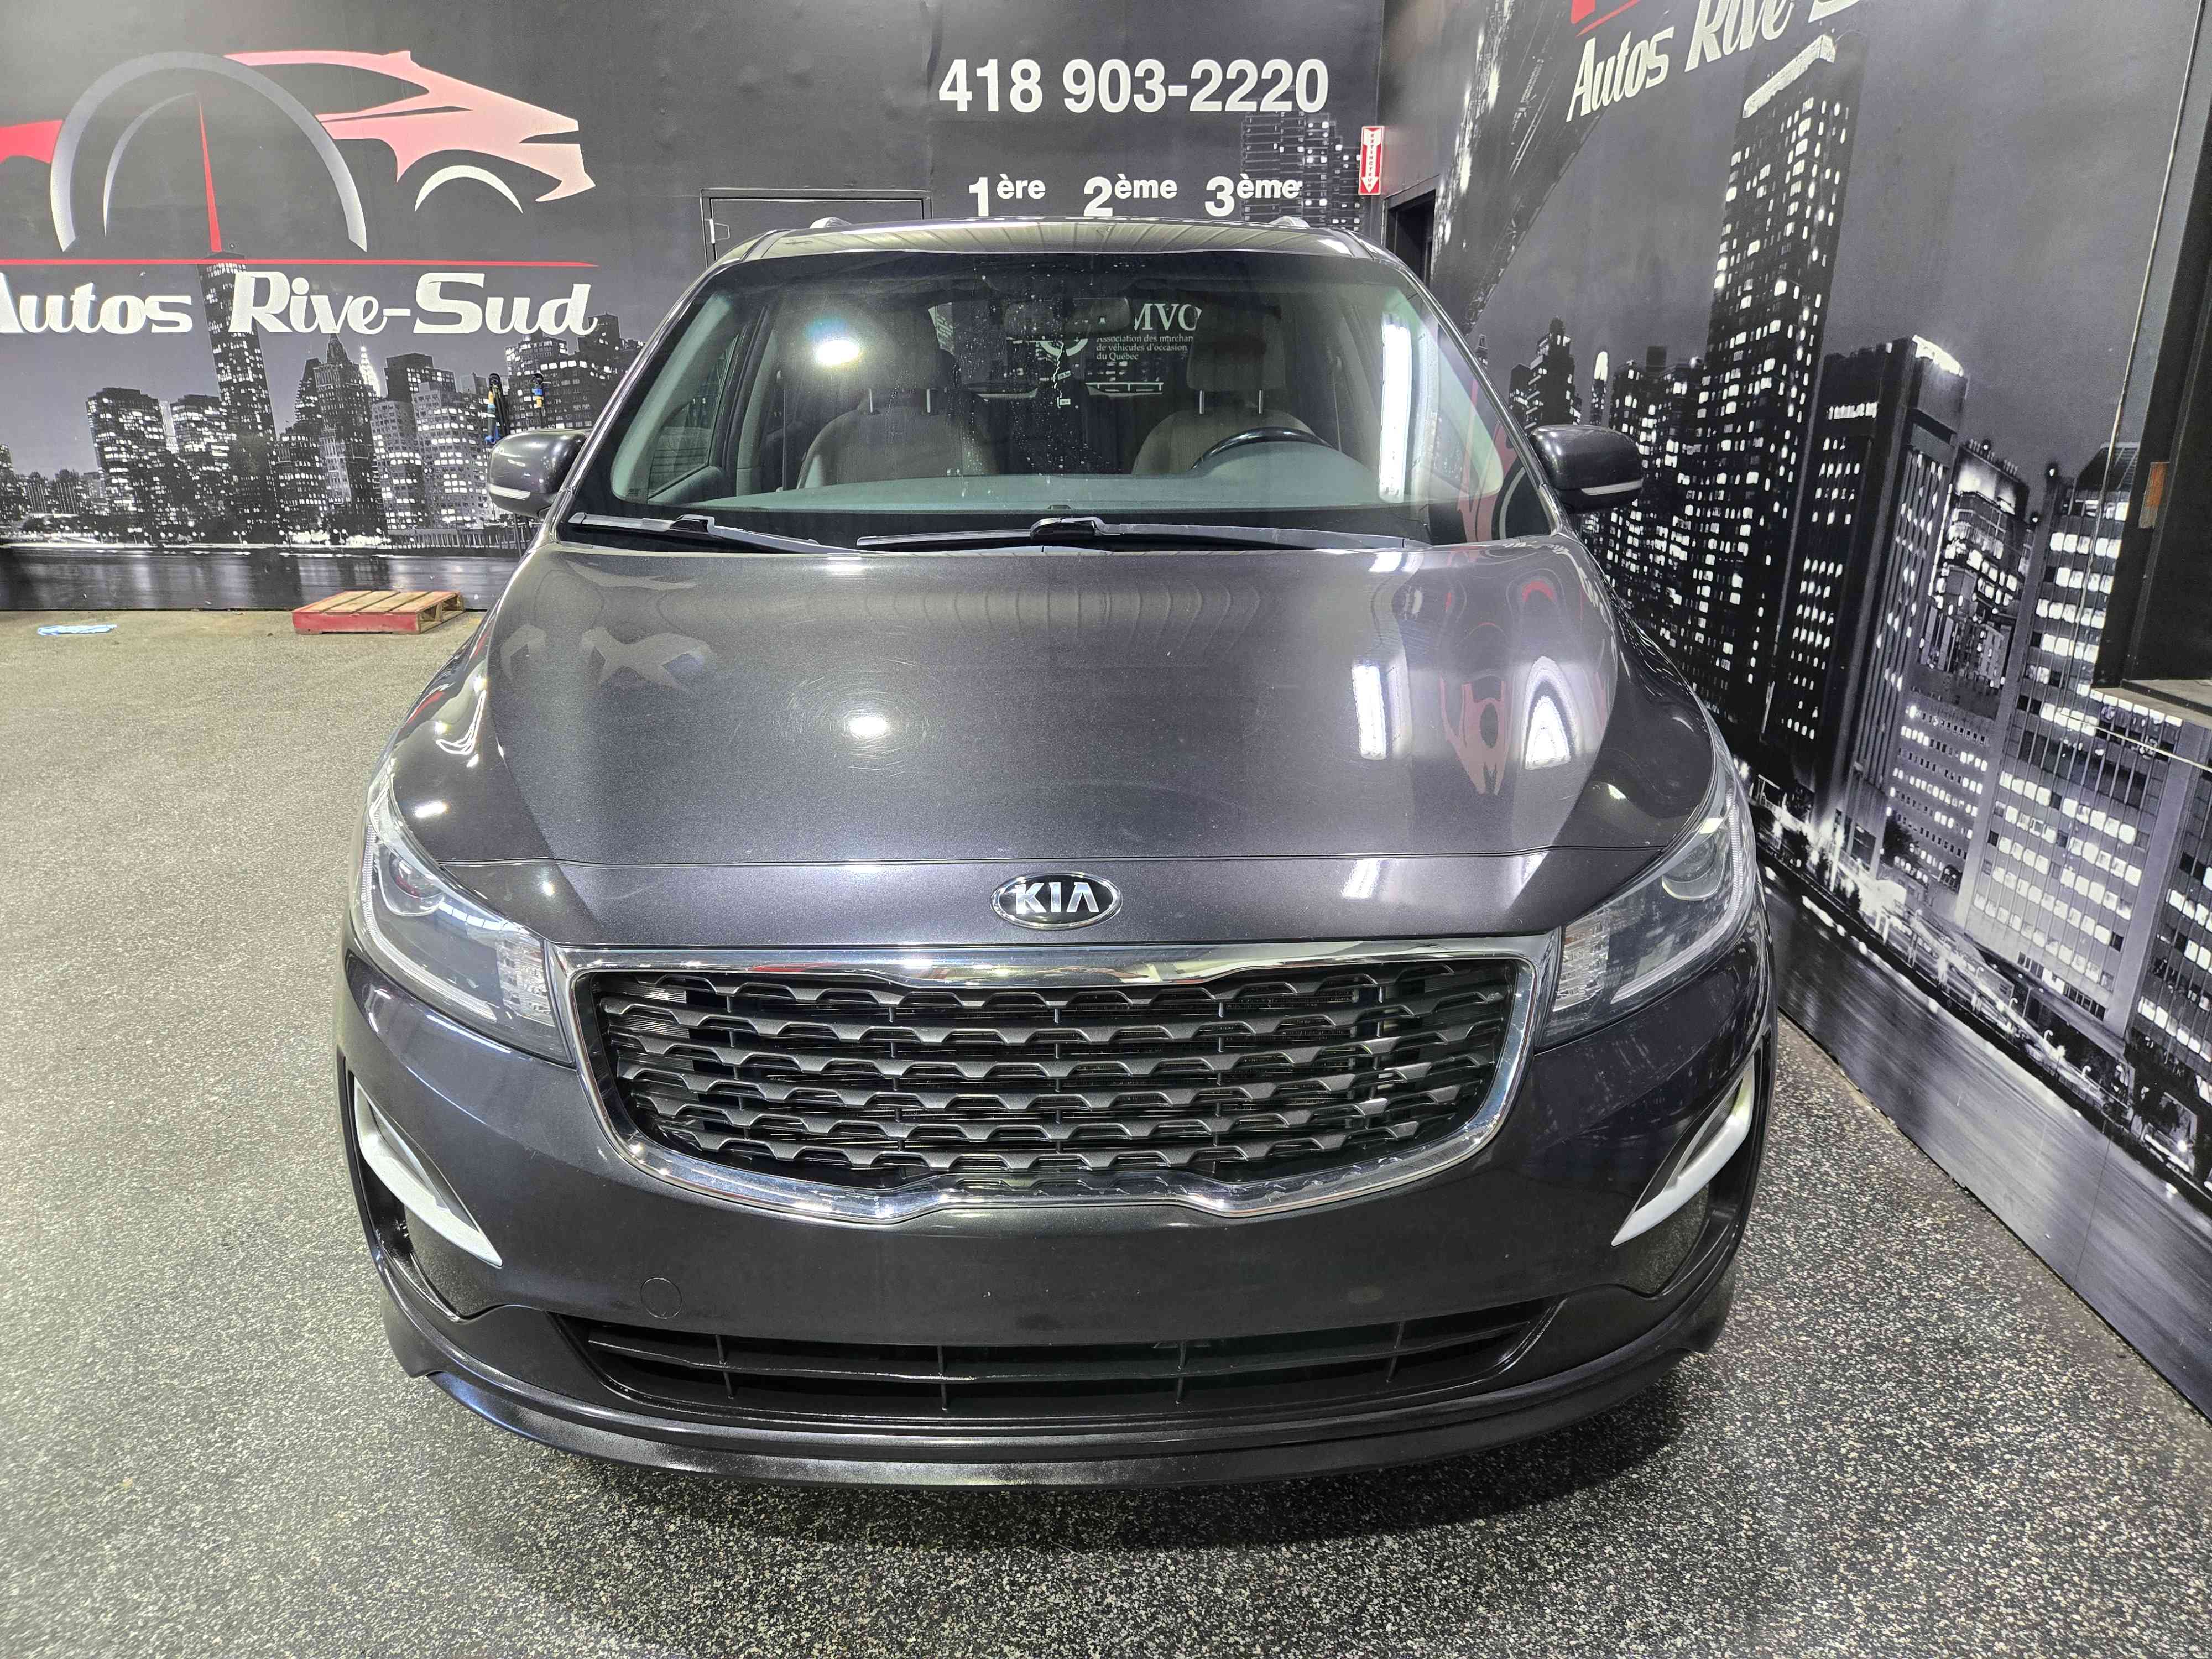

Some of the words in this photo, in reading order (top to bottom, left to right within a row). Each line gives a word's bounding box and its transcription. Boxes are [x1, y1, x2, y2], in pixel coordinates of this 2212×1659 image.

[938, 59, 1043, 113] 418
[1062, 59, 1328, 113] 903-2220
[1566, 25, 1675, 122] Autos
[969, 173, 1046, 217] 1ère
[1083, 173, 1178, 217] 2ème
[1204, 173, 1303, 217] 3ème
[228, 270, 598, 335] Rive-Sud
[1108, 343, 1145, 351] véhicules
[1146, 343, 1187, 351] d'occasion
[1109, 352, 1139, 362] Québec
[1144, 334, 1157, 342] des
[1015, 881, 1099, 914] KIA
